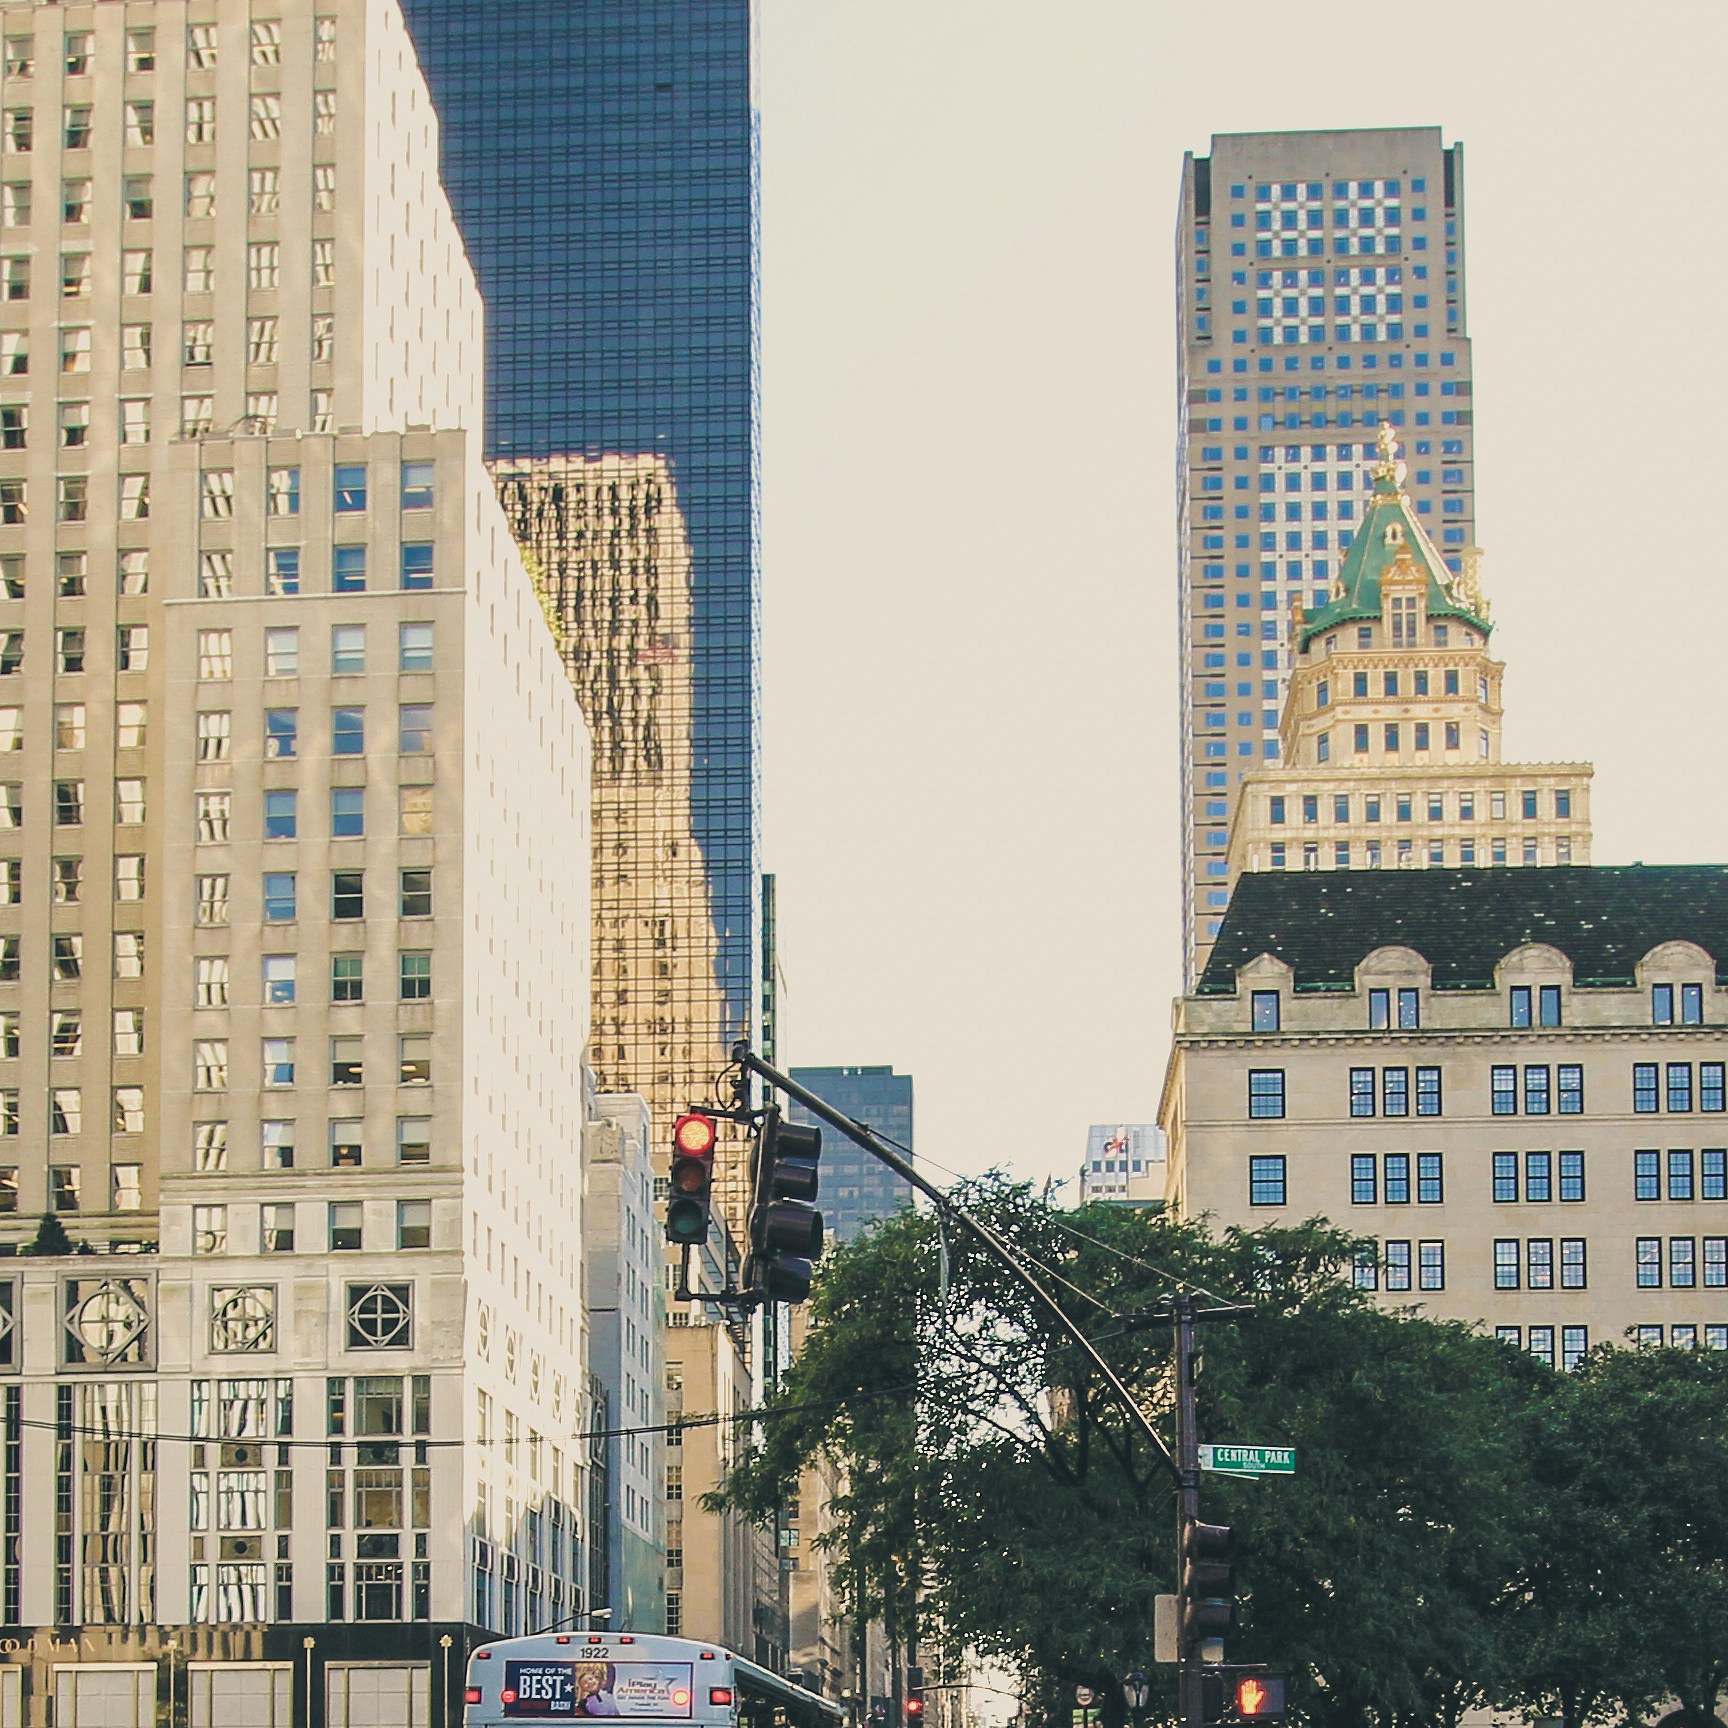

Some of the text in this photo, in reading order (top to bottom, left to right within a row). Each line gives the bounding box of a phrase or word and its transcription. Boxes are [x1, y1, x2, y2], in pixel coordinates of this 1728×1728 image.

[1217, 1448, 1290, 1464] CENTRAL PARK
[580, 1647, 609, 1658] 1922
[545, 1667, 556, 1675] OF
[519, 1675, 565, 1699] BEST
